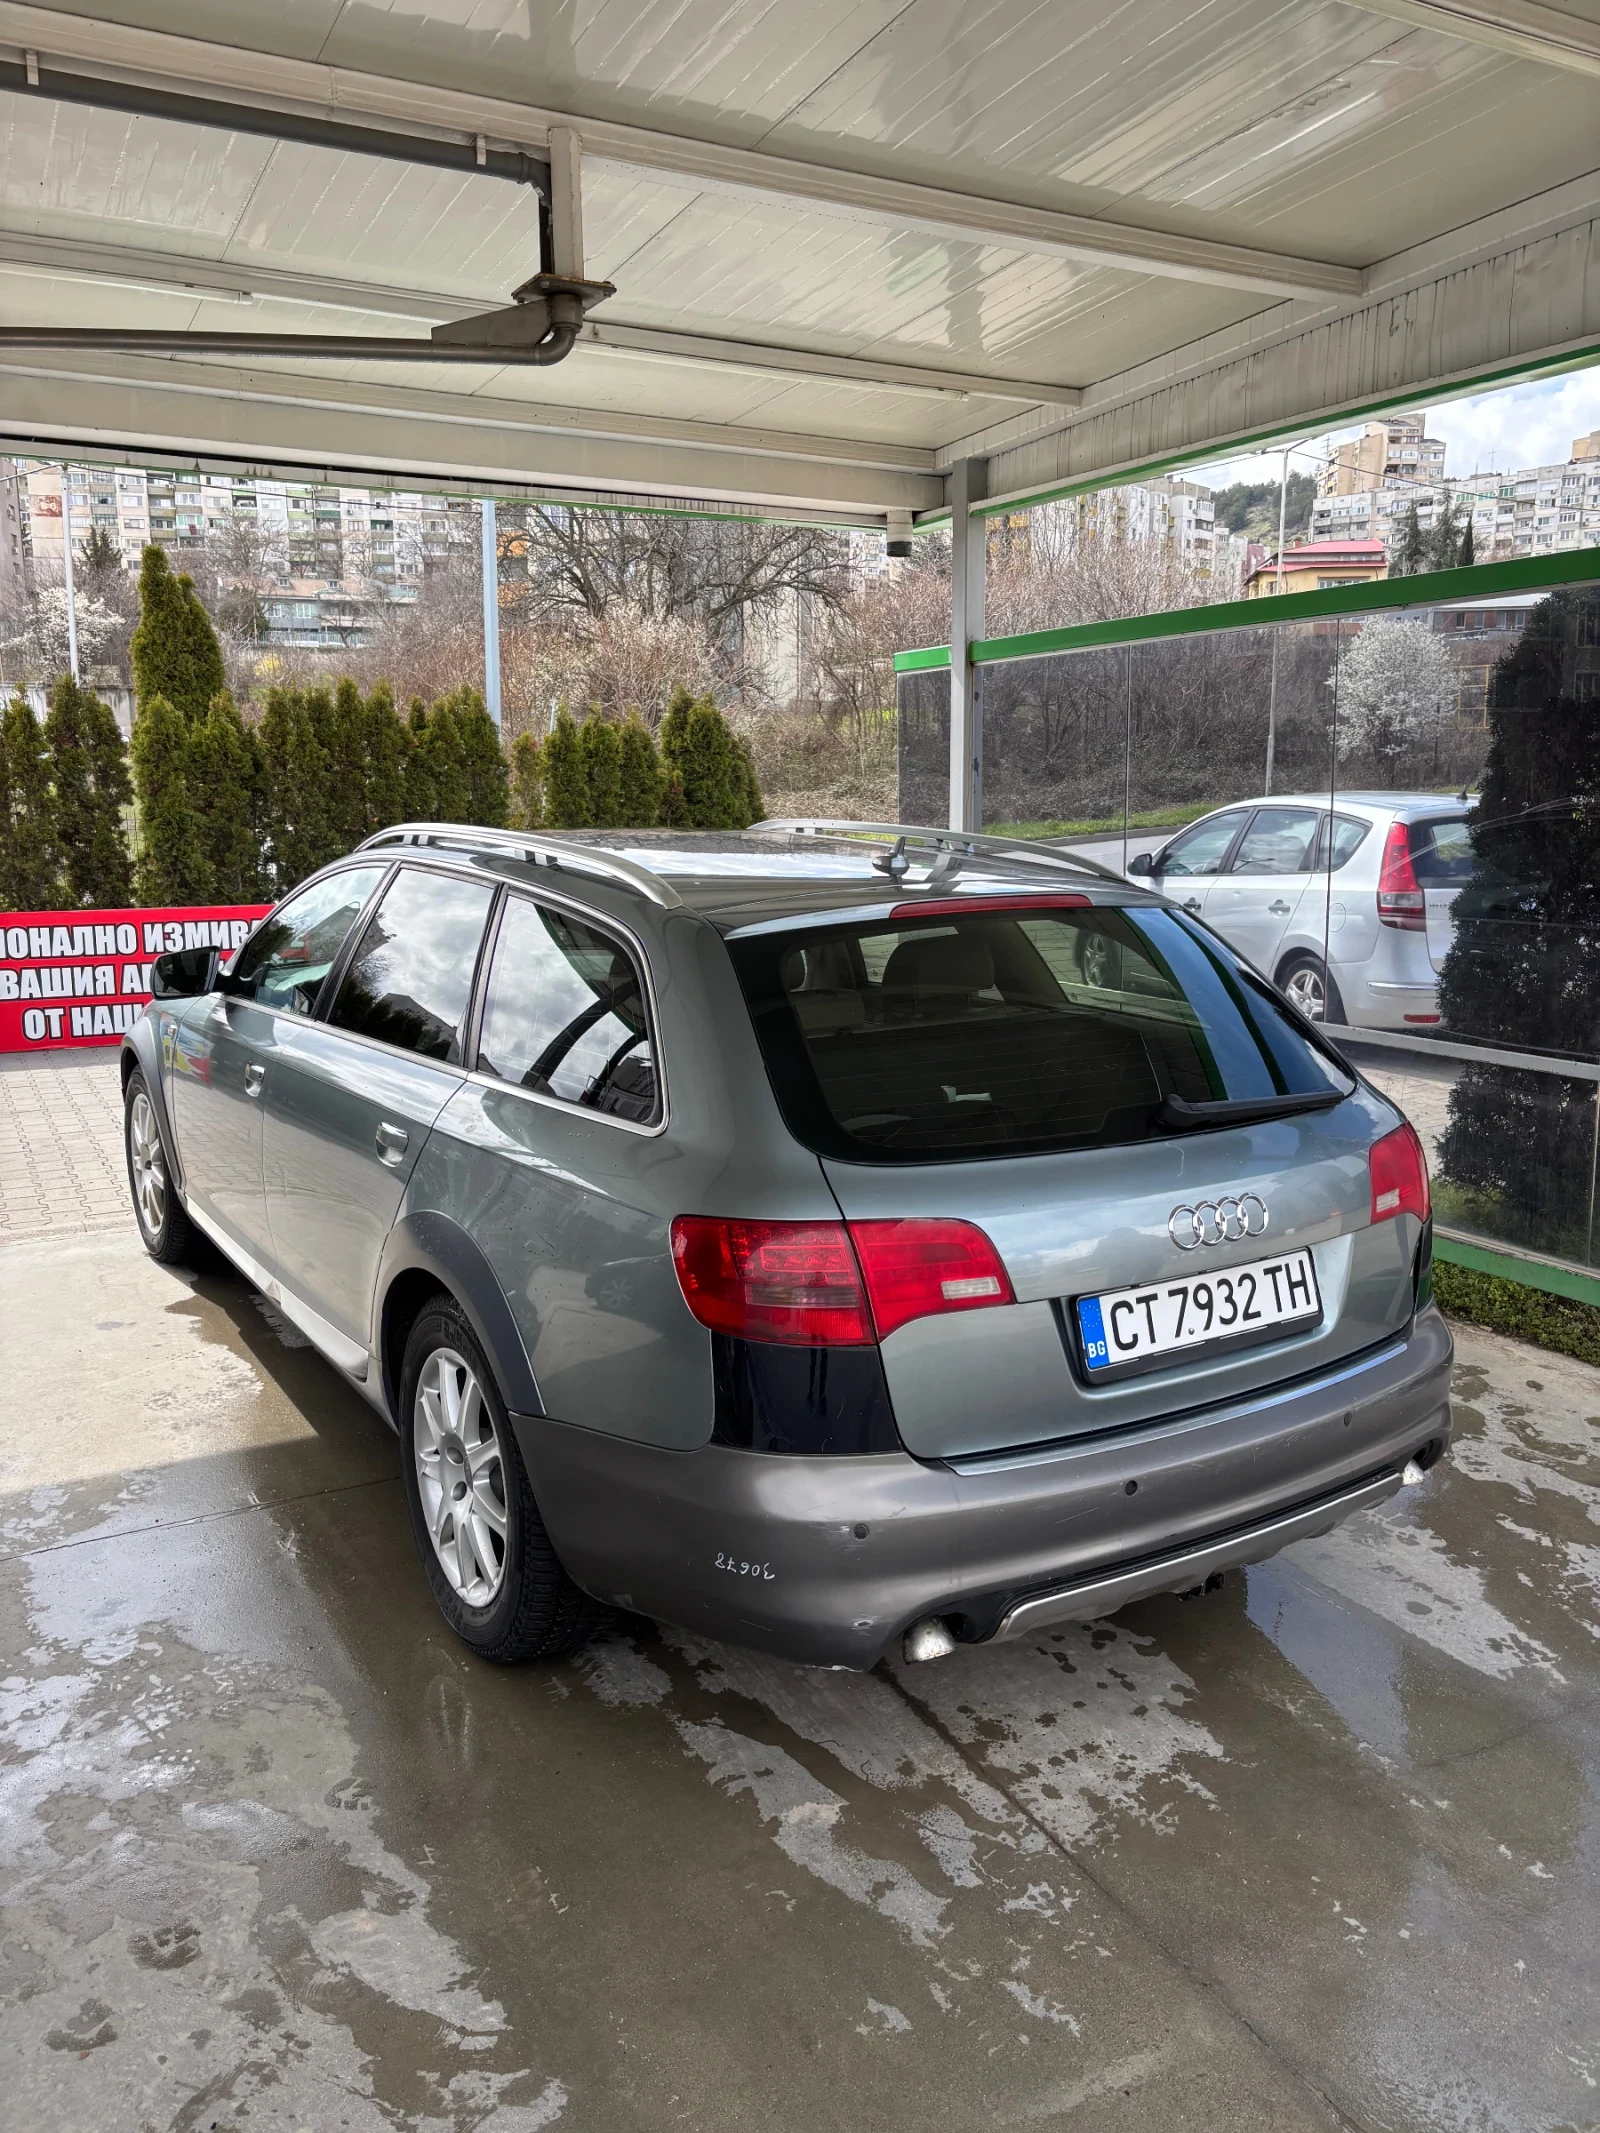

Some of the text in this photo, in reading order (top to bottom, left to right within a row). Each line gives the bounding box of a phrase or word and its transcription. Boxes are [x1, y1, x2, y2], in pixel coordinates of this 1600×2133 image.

[0, 964, 116, 1000] ВАШИЯ
[24, 1007, 64, 1040] ОТ
[1110, 1259, 1311, 1351] CT 7932 TH
[1087, 1340, 1106, 1358] BG
